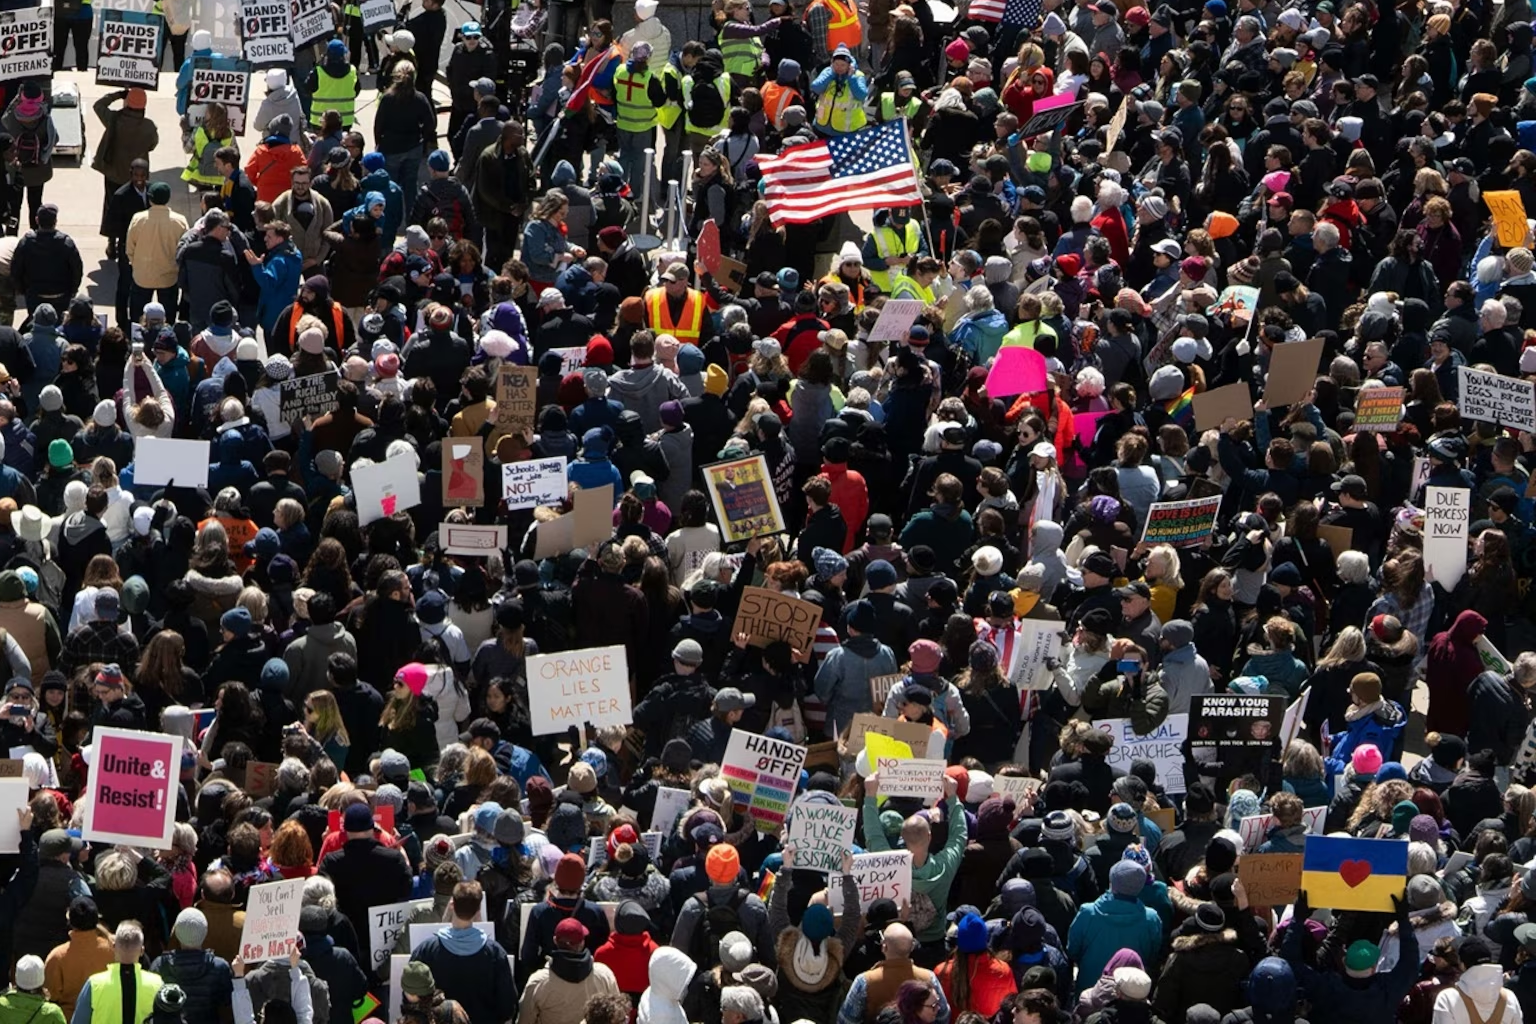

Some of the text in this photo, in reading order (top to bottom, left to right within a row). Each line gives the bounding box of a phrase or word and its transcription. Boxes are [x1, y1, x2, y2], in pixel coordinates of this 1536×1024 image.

[244, 5, 286, 17] HANDS
[0, 20, 47, 36] HANDS
[106, 24, 155, 37] HANDS
[246, 16, 287, 35] OFF!
[301, 23, 325, 40] SERVICE
[250, 43, 288, 57] SCIENCE
[0, 58, 49, 74] VETERANS
[119, 59, 137, 70] OUR
[101, 67, 155, 82] CIVIL RIGHTS
[195, 72, 245, 84] HANDS
[282, 376, 324, 392] TAX THE
[502, 374, 531, 388] IKEA
[284, 391, 339, 408] AND GREEDY
[294, 385, 316, 399] RICH
[505, 388, 528, 399] HAS
[1364, 391, 1403, 399] INJUSTICE
[498, 400, 534, 411] BETTER
[1367, 415, 1398, 423] JUSTICE
[1492, 409, 1535, 427] LESS SAFE
[506, 481, 535, 496] NOT
[1436, 492, 1461, 506] DUE
[1426, 506, 1468, 521] PROCESS
[1433, 523, 1462, 535] NOW
[740, 593, 818, 633] STOP!
[736, 615, 813, 659] THIEVES!
[539, 655, 613, 681] ORANGE
[561, 679, 601, 697] LIES
[549, 697, 621, 721] MATTER
[1202, 697, 1270, 708] KNOW YOUR
[1201, 706, 1269, 717] PARASITES
[744, 736, 805, 764] HANDS
[1107, 742, 1184, 765] BRANCHES
[103, 753, 166, 779] Unite&
[754, 758, 800, 781] OFF!
[877, 759, 898, 768] NO
[887, 767, 945, 777] DEPORTATION
[98, 784, 163, 811] Resist!
[795, 806, 857, 831] A WOMAN'S
[804, 821, 845, 843] PLACE
[869, 869, 898, 883] DON
[375, 910, 404, 928] THE
